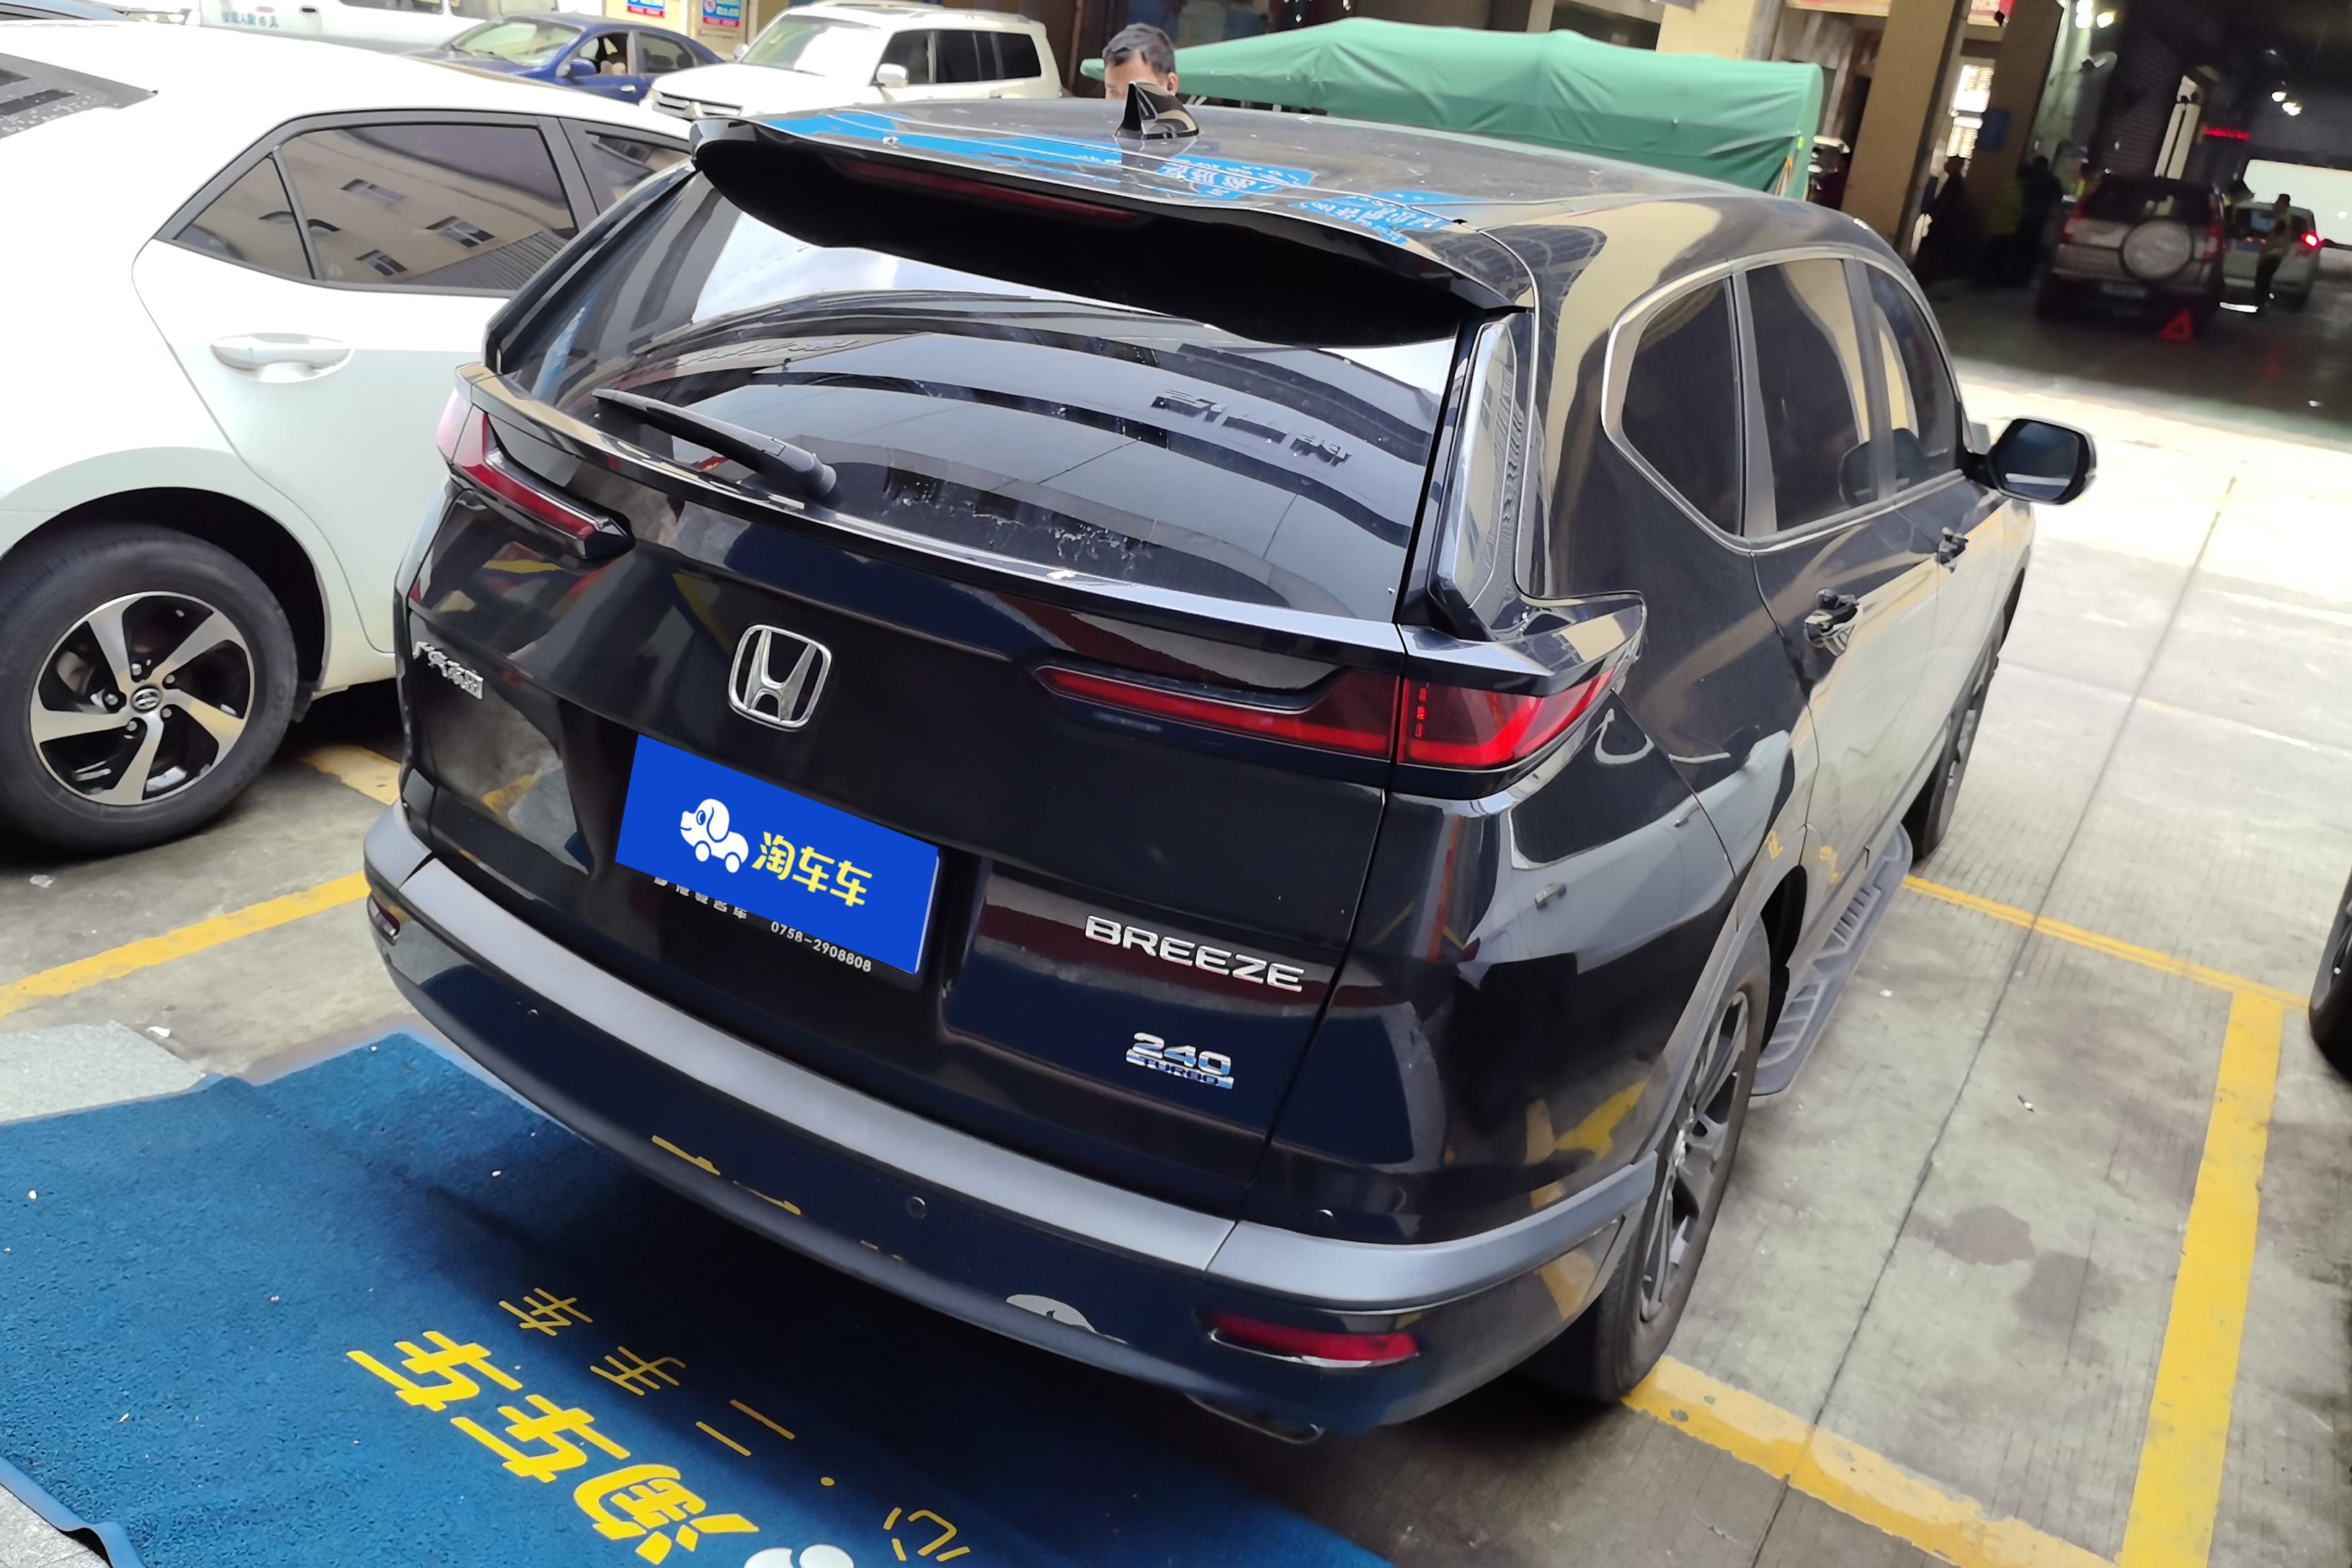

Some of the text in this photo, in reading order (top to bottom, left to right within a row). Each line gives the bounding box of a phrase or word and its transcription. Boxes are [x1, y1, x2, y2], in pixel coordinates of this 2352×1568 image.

[411, 640, 484, 700] 广汽本田
[770, 921, 872, 972] 0758-2908808
[1085, 914, 1305, 992] BREEZE
[1132, 1032, 1231, 1076] 240
[1133, 1052, 1225, 1087] TURBO
[348, 1331, 758, 1565] 淘车车
